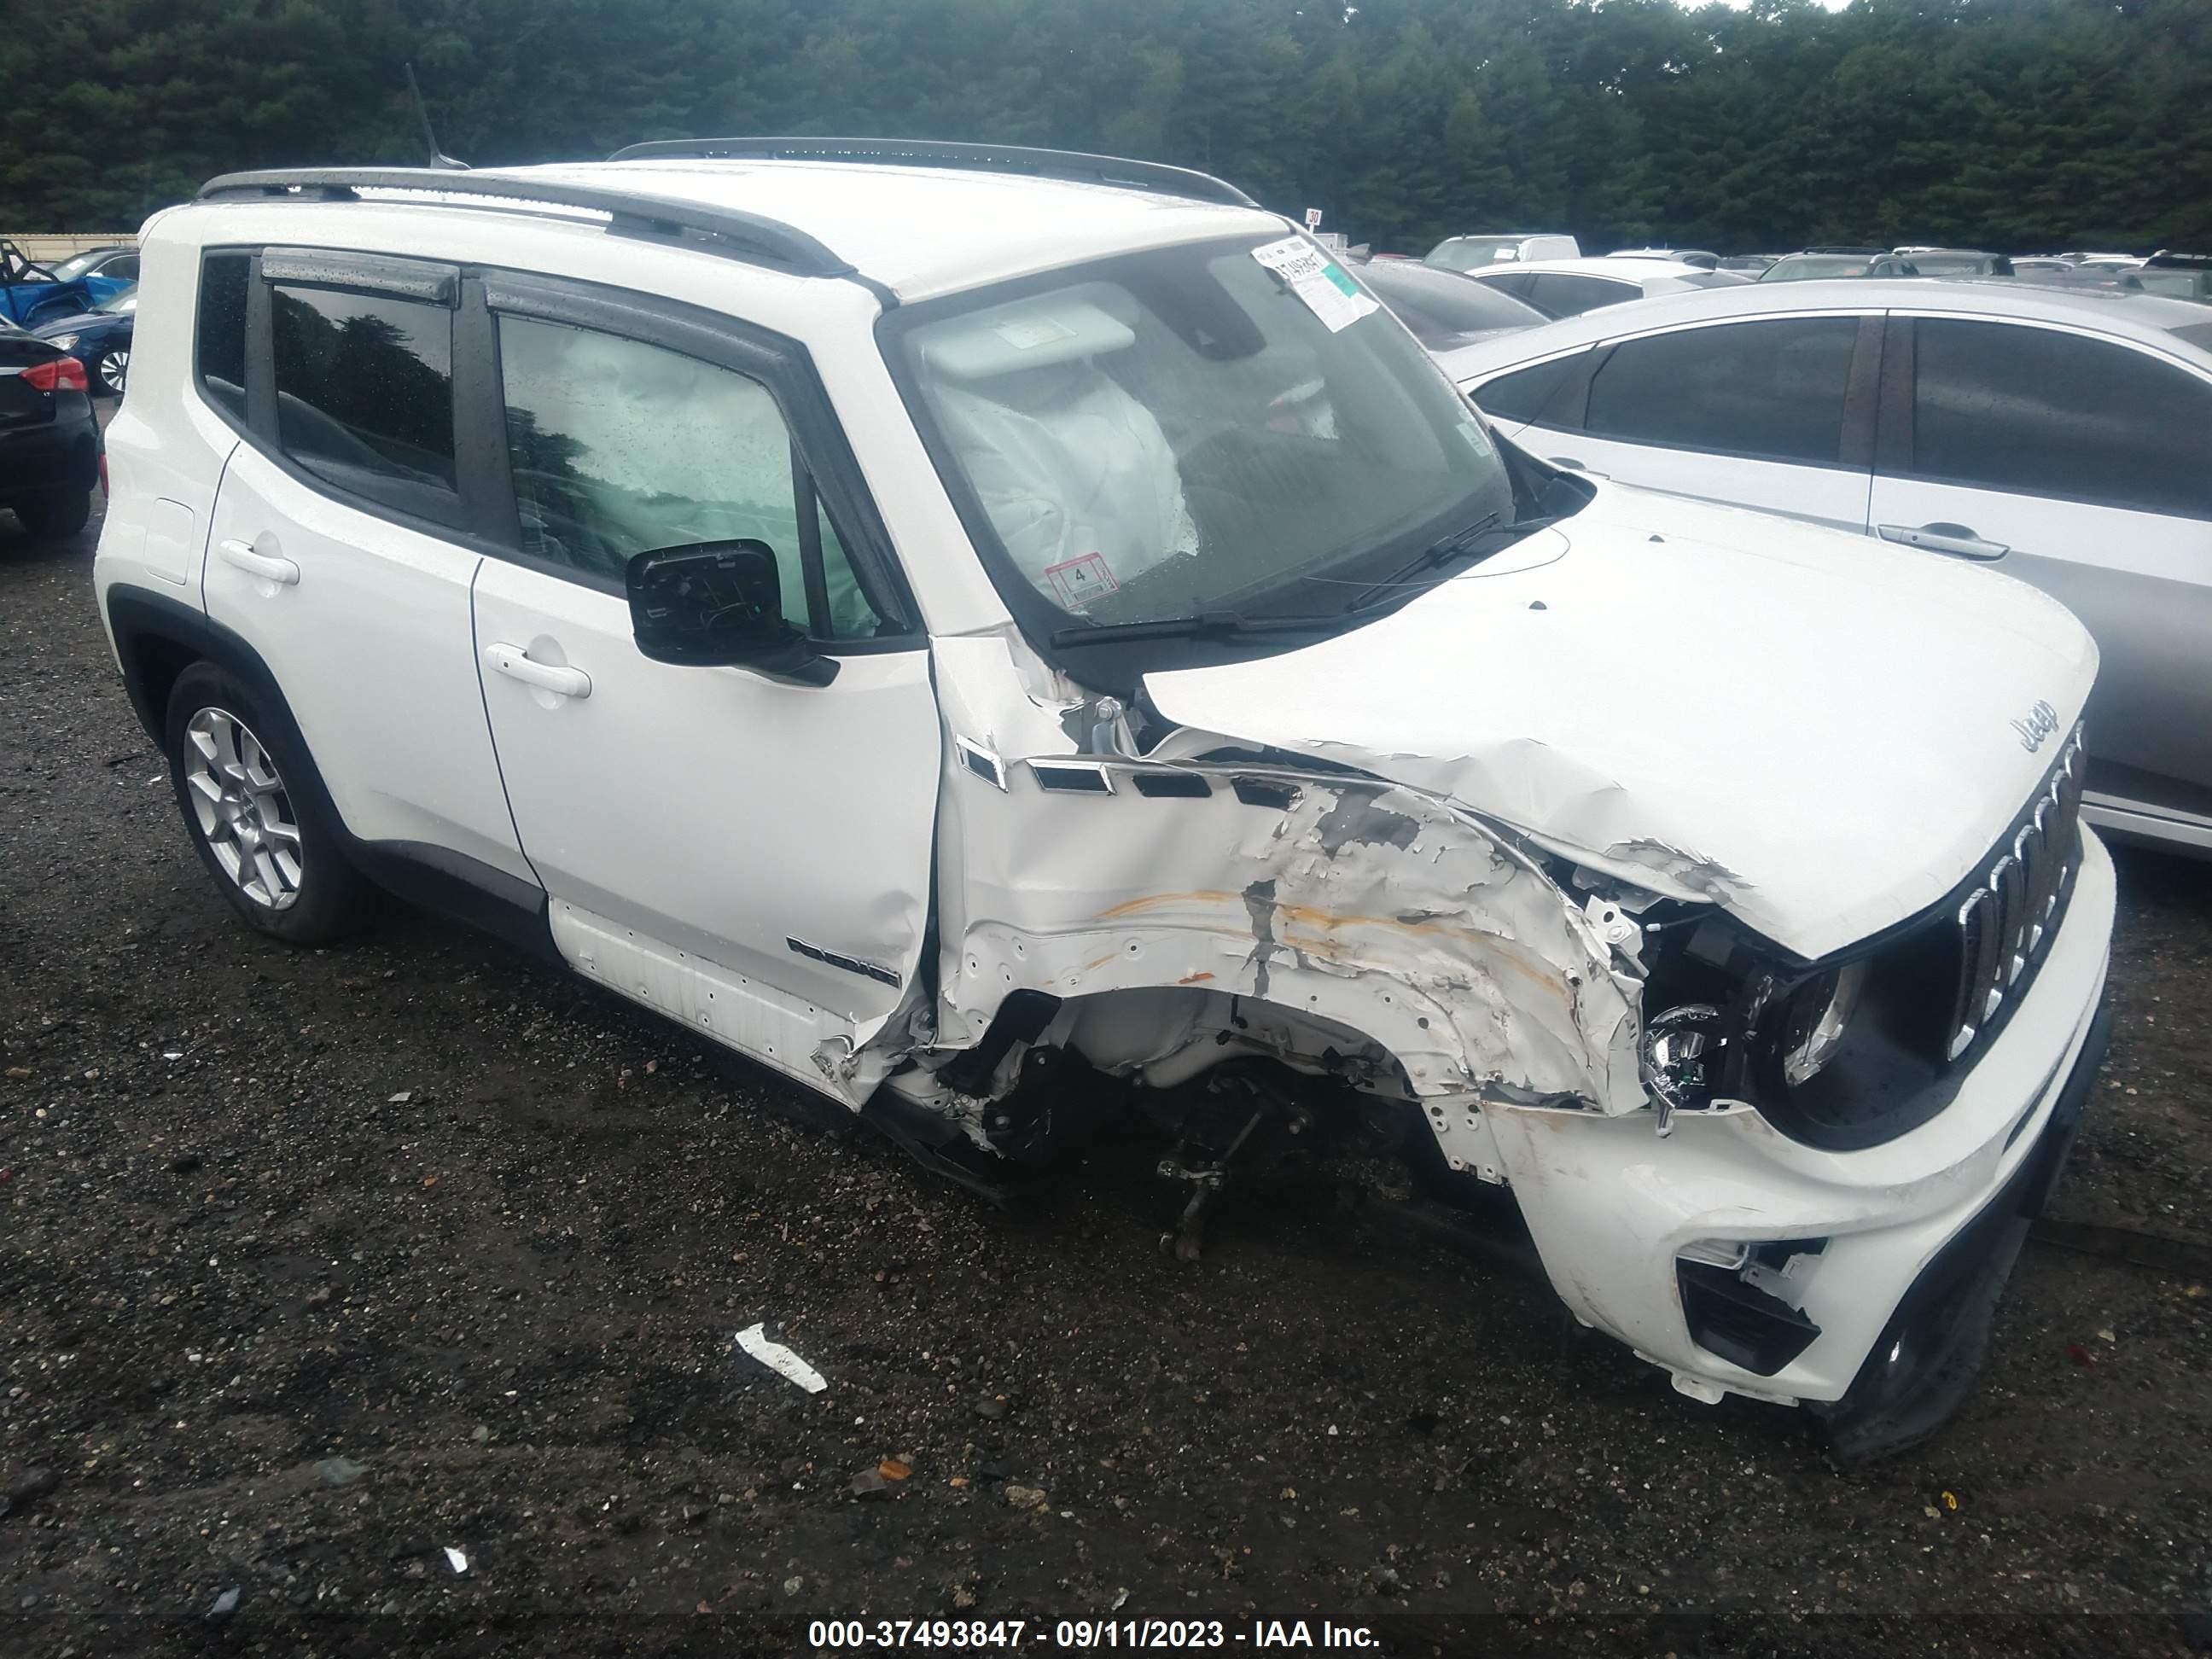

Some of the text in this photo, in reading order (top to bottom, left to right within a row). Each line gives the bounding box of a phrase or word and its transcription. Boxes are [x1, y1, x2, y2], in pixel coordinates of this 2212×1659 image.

[1310, 211, 1318, 223] 30
[1075, 568, 1086, 581] 4
[2009, 699, 2059, 753] Jeep
